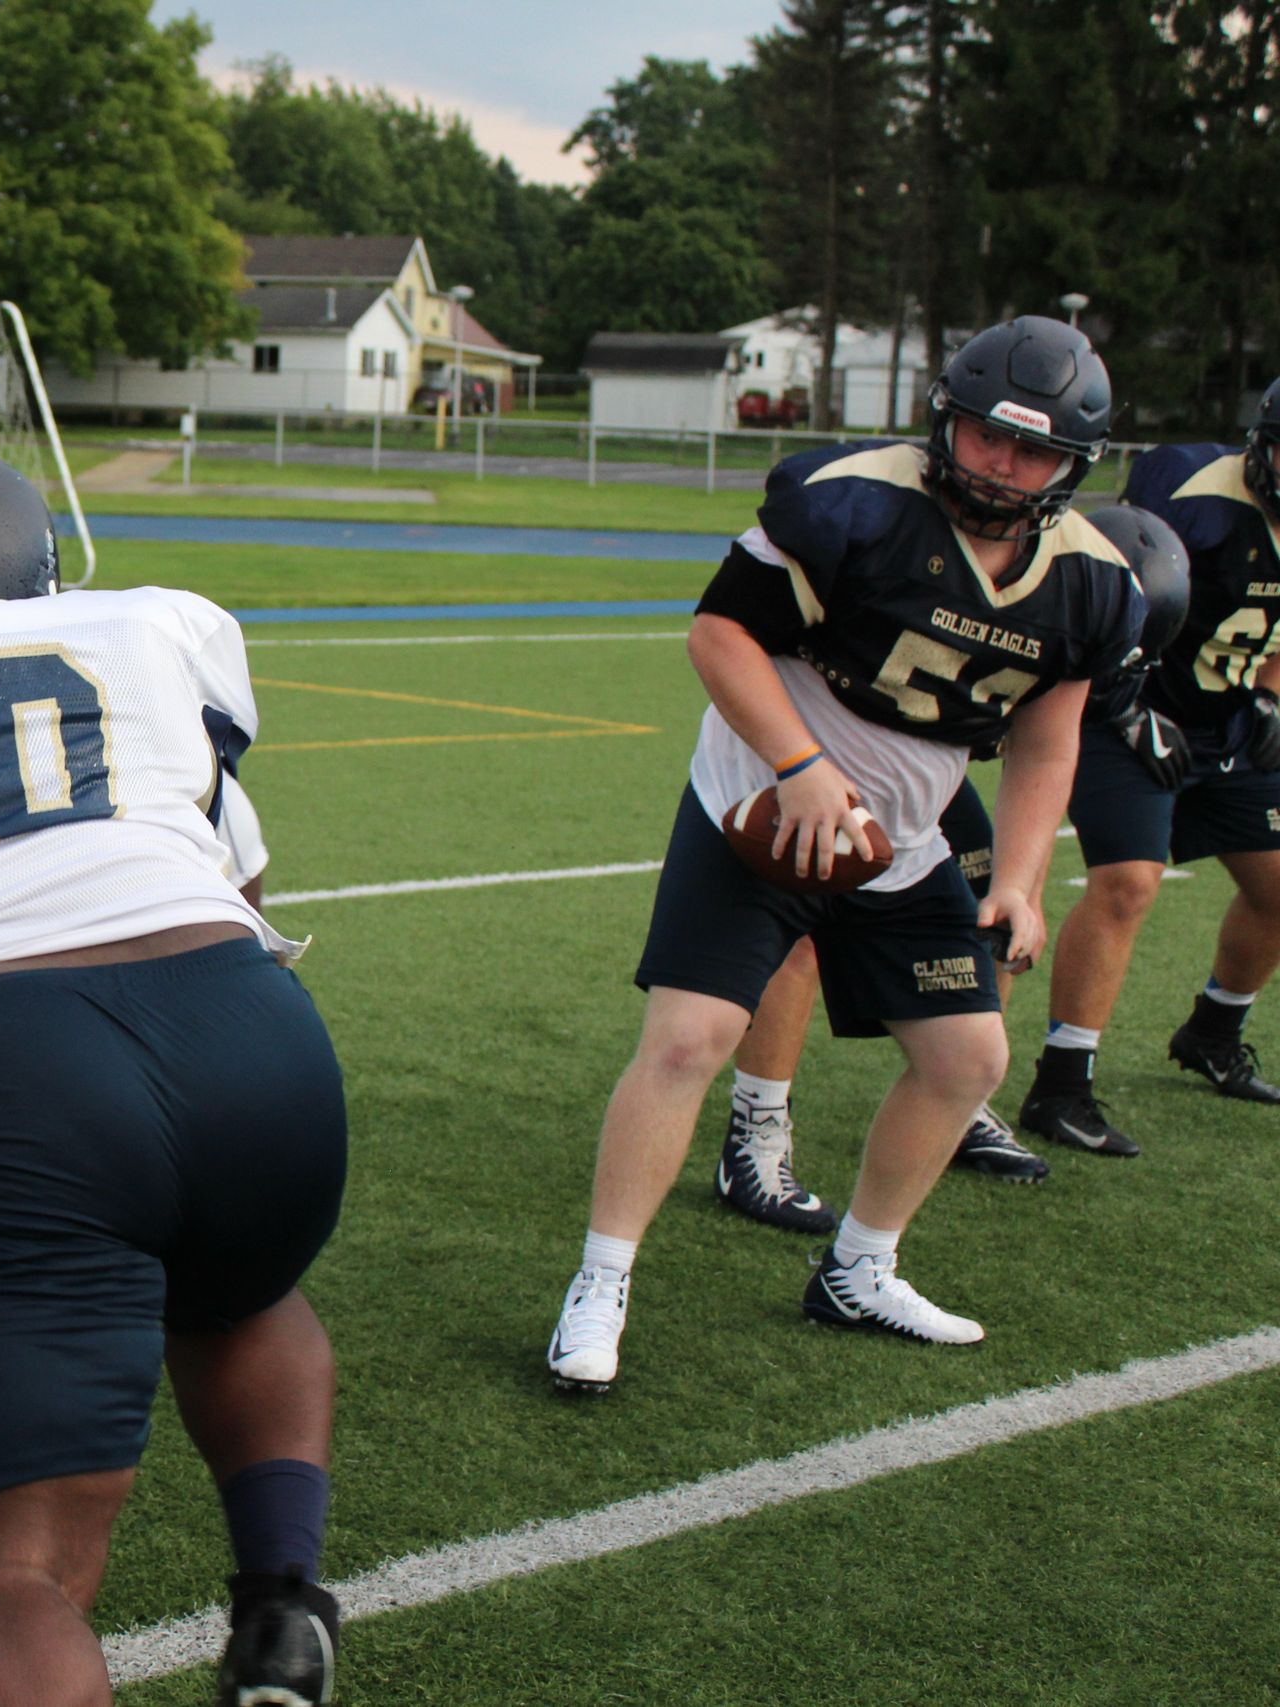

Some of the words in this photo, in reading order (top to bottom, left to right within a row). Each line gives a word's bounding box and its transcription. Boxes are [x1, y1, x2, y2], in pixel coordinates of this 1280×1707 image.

[931, 607, 989, 644] GOLDEN
[989, 627, 1042, 660] EAGLES
[1193, 607, 1280, 692] 6
[913, 956, 976, 977] CLARION
[917, 974, 979, 992] FOOTBALL
